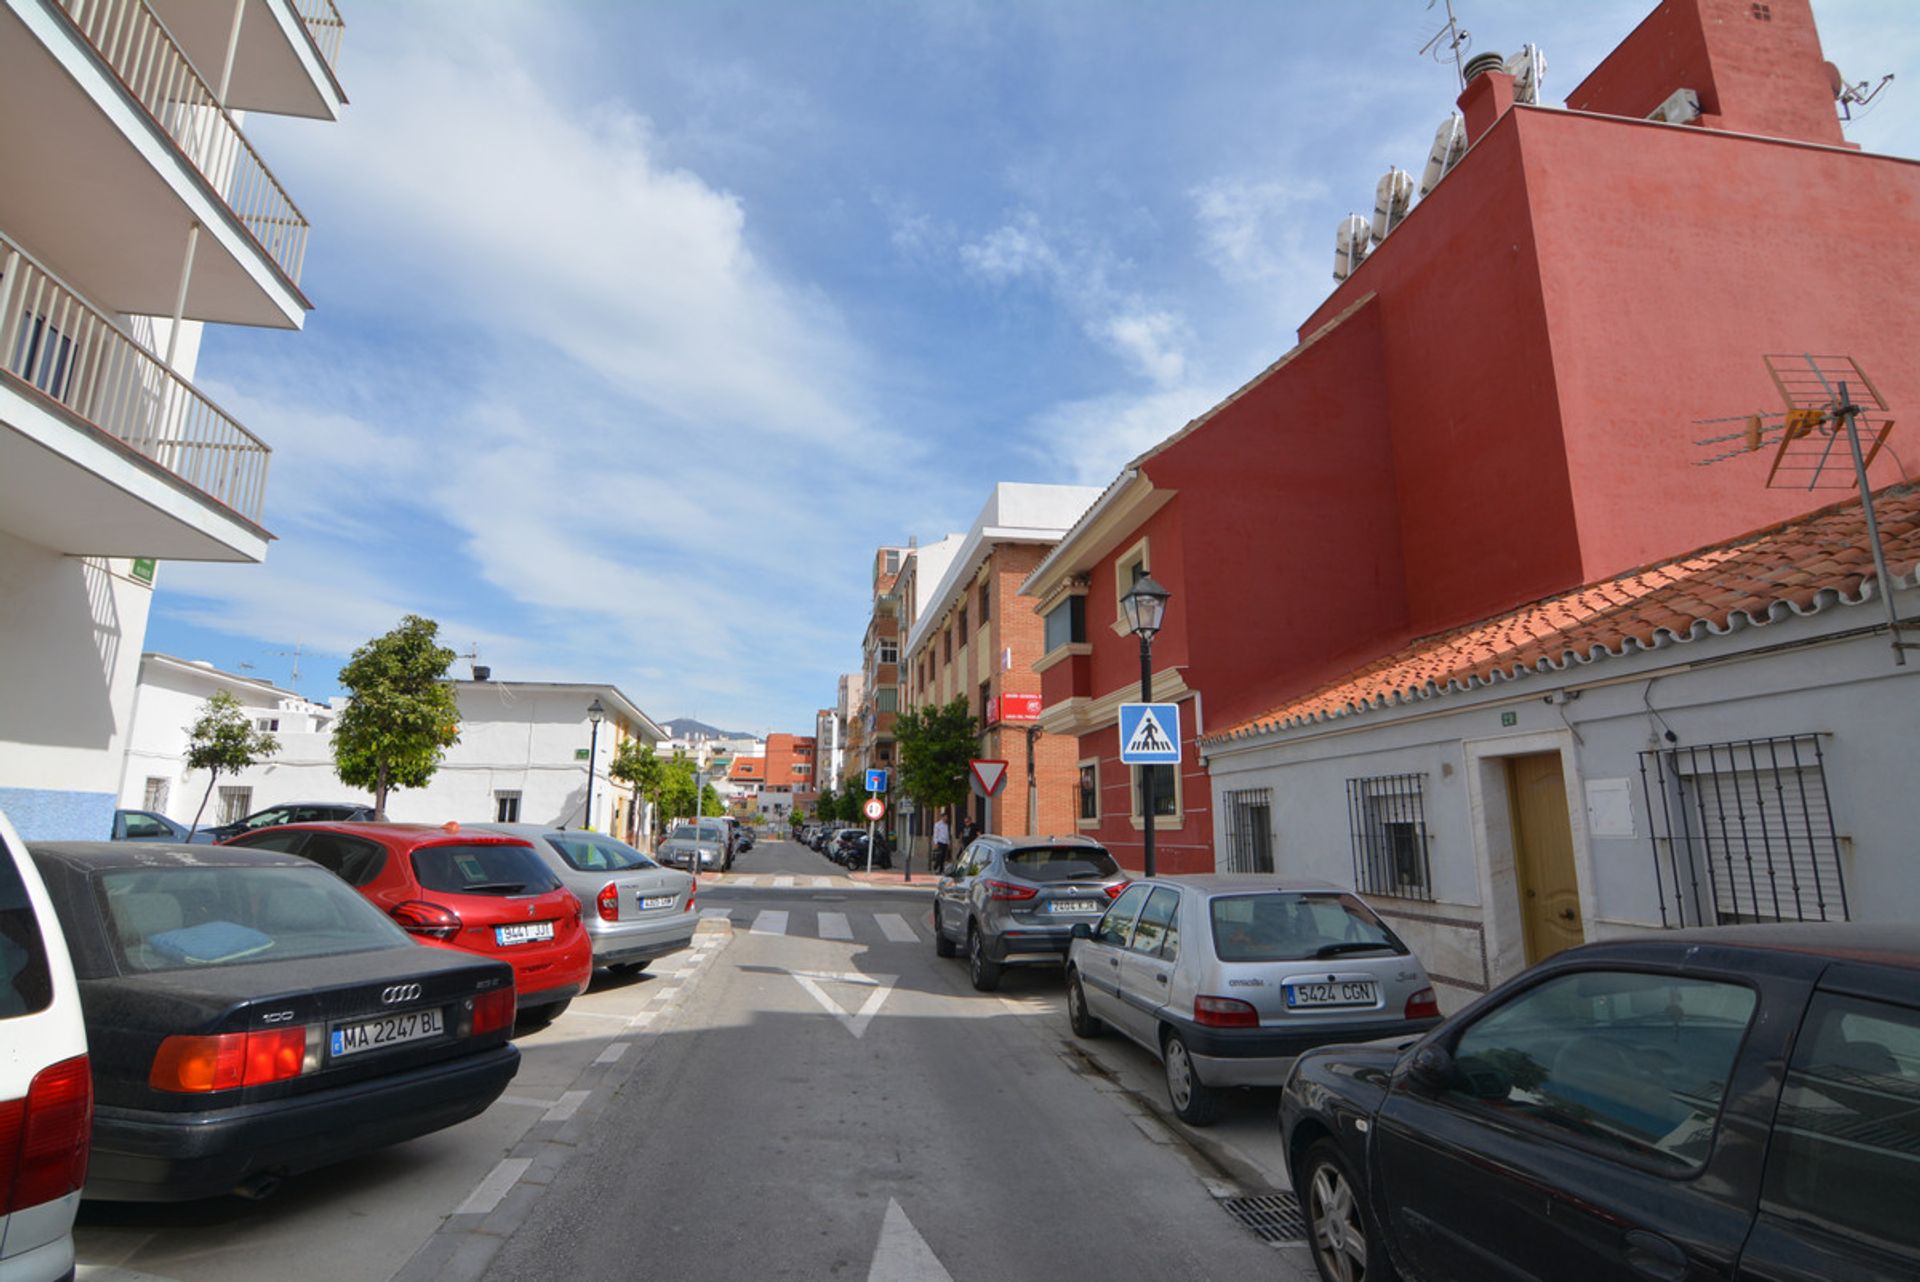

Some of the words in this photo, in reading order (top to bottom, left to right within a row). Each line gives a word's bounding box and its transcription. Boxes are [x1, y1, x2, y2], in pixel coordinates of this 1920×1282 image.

[1299, 985, 1335, 1002] 5424
[1342, 984, 1370, 1000] CGN
[262, 1011, 294, 1022] 100
[343, 1025, 369, 1050] MA
[374, 1015, 416, 1043] 2247
[422, 1011, 442, 1033] BL
